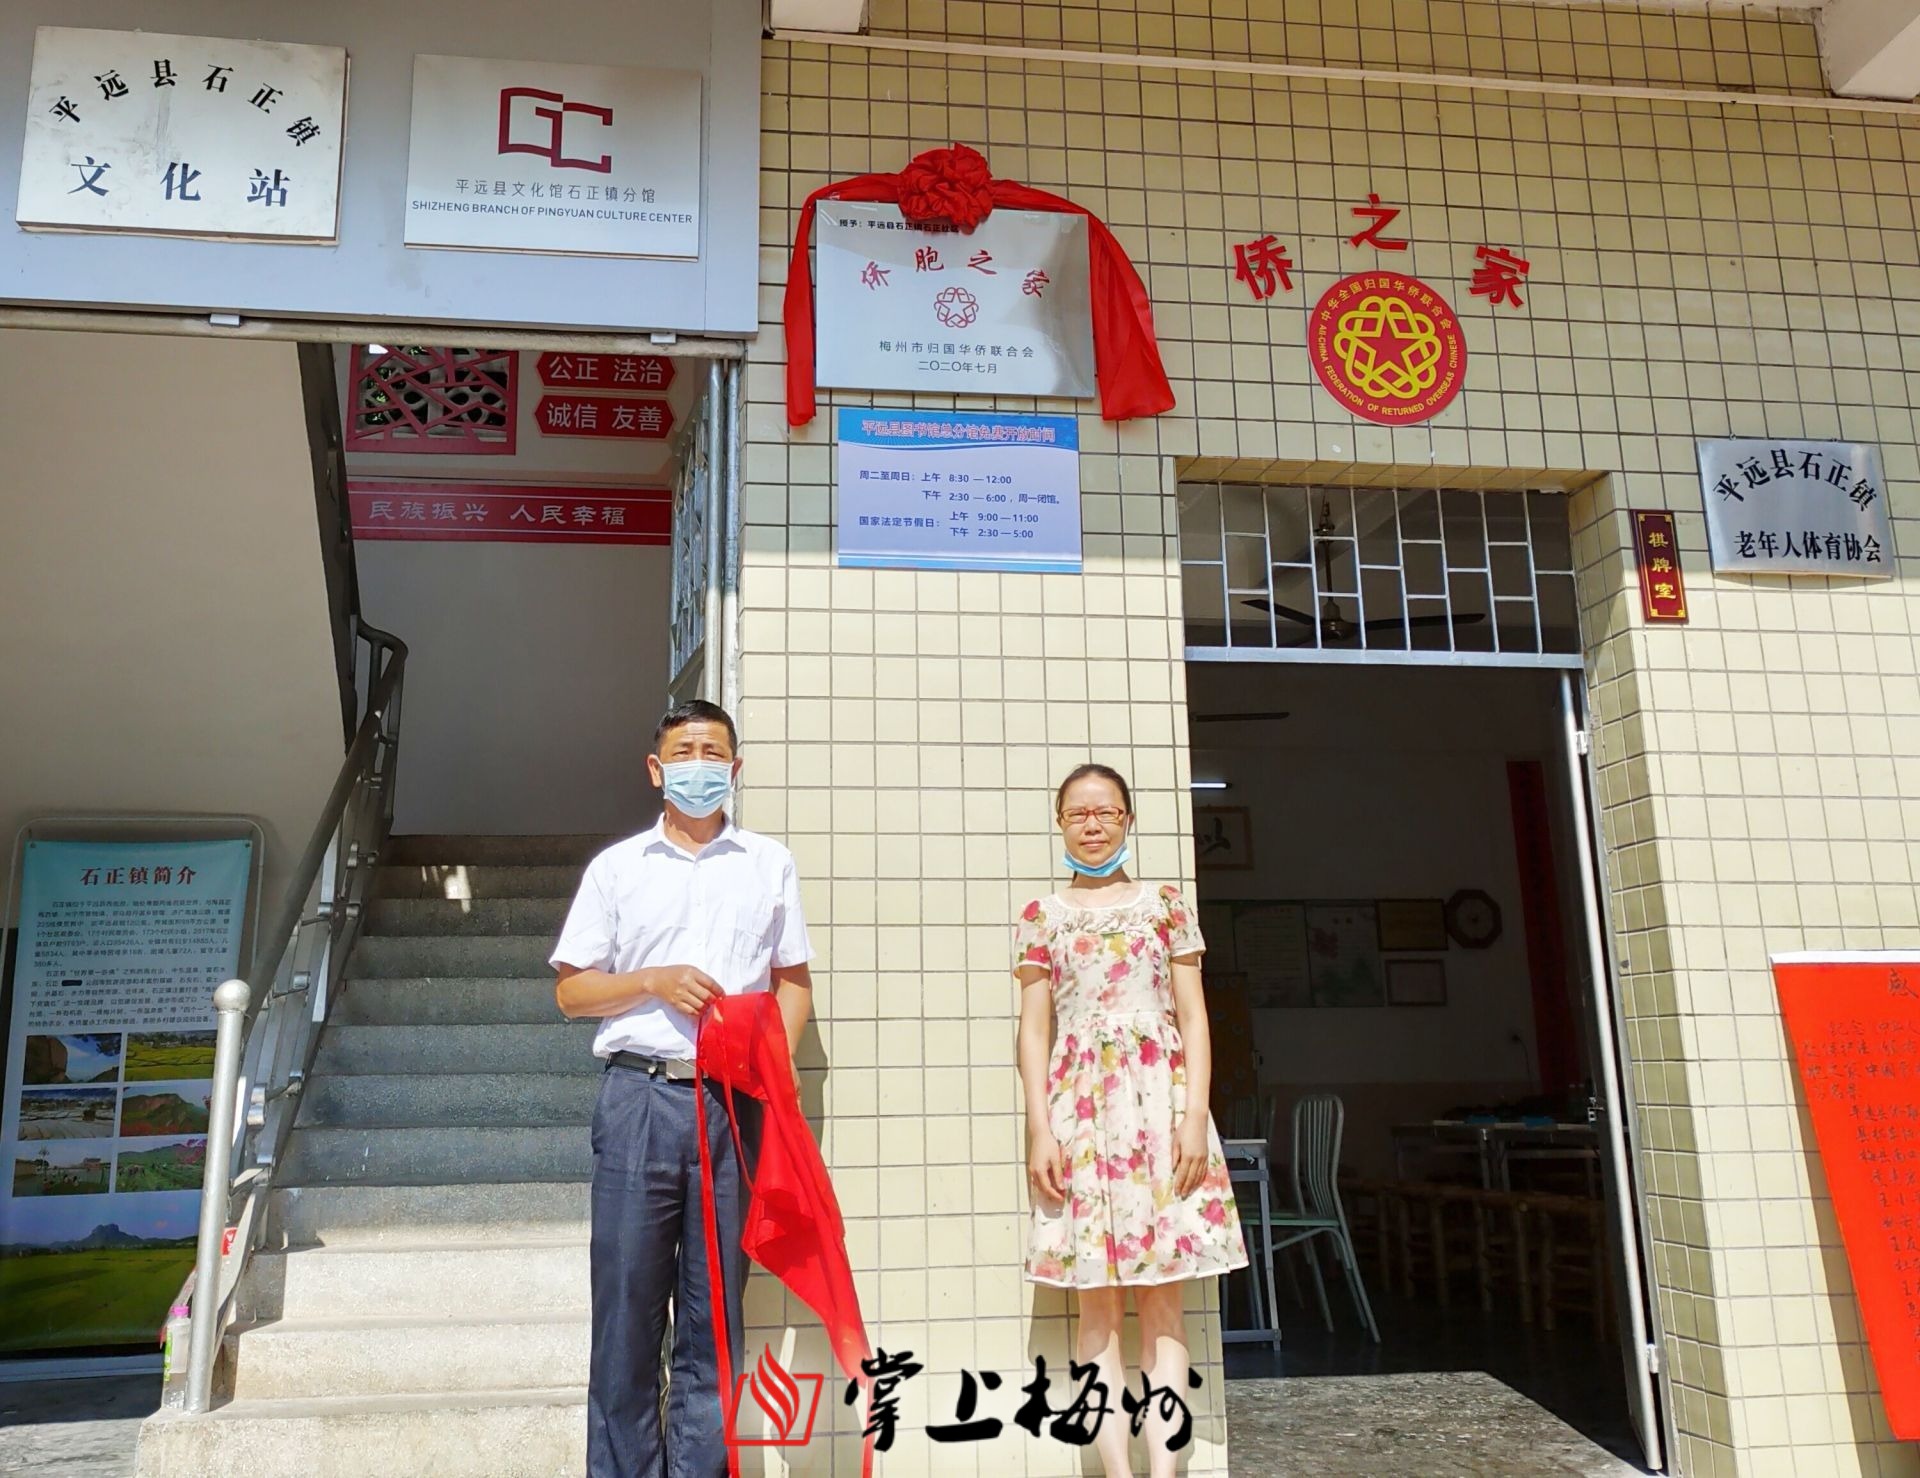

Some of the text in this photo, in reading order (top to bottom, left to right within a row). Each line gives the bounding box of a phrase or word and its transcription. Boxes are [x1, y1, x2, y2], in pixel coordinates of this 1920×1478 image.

[48, 57, 322, 148] 平远县石正镇
[67, 156, 291, 208] 文化站
[456, 178, 656, 204] 平远县文化馆石正镇分馆
[412, 200, 693, 224] SHIZHENG BRANCH OF PINGYUAN CULTURE CENTER
[861, 246, 1050, 298] 侨胞之家
[1233, 193, 1531, 309] 侨之家
[1320, 278, 1453, 330] 中华全国归国华侨联合会
[549, 355, 664, 384] 公正 法治
[878, 340, 1035, 359] 梅州市归国华侨联合会
[1324, 365, 1364, 406] FEDERATION
[1367, 403, 1379, 413] OF
[1381, 402, 1425, 416] RETURNED
[1426, 371, 1455, 407] OVERSEAS
[1446, 333, 1458, 369] CHINESE
[546, 402, 663, 432] 诚信 友善
[1712, 449, 1878, 512] 平远县石正镇
[368, 501, 627, 526] 民族振兴 人民幸福
[1648, 532, 1677, 600] 棋牌室
[1734, 531, 1882, 563] 老年人体育协会
[80, 865, 197, 886] 石正镇简介
